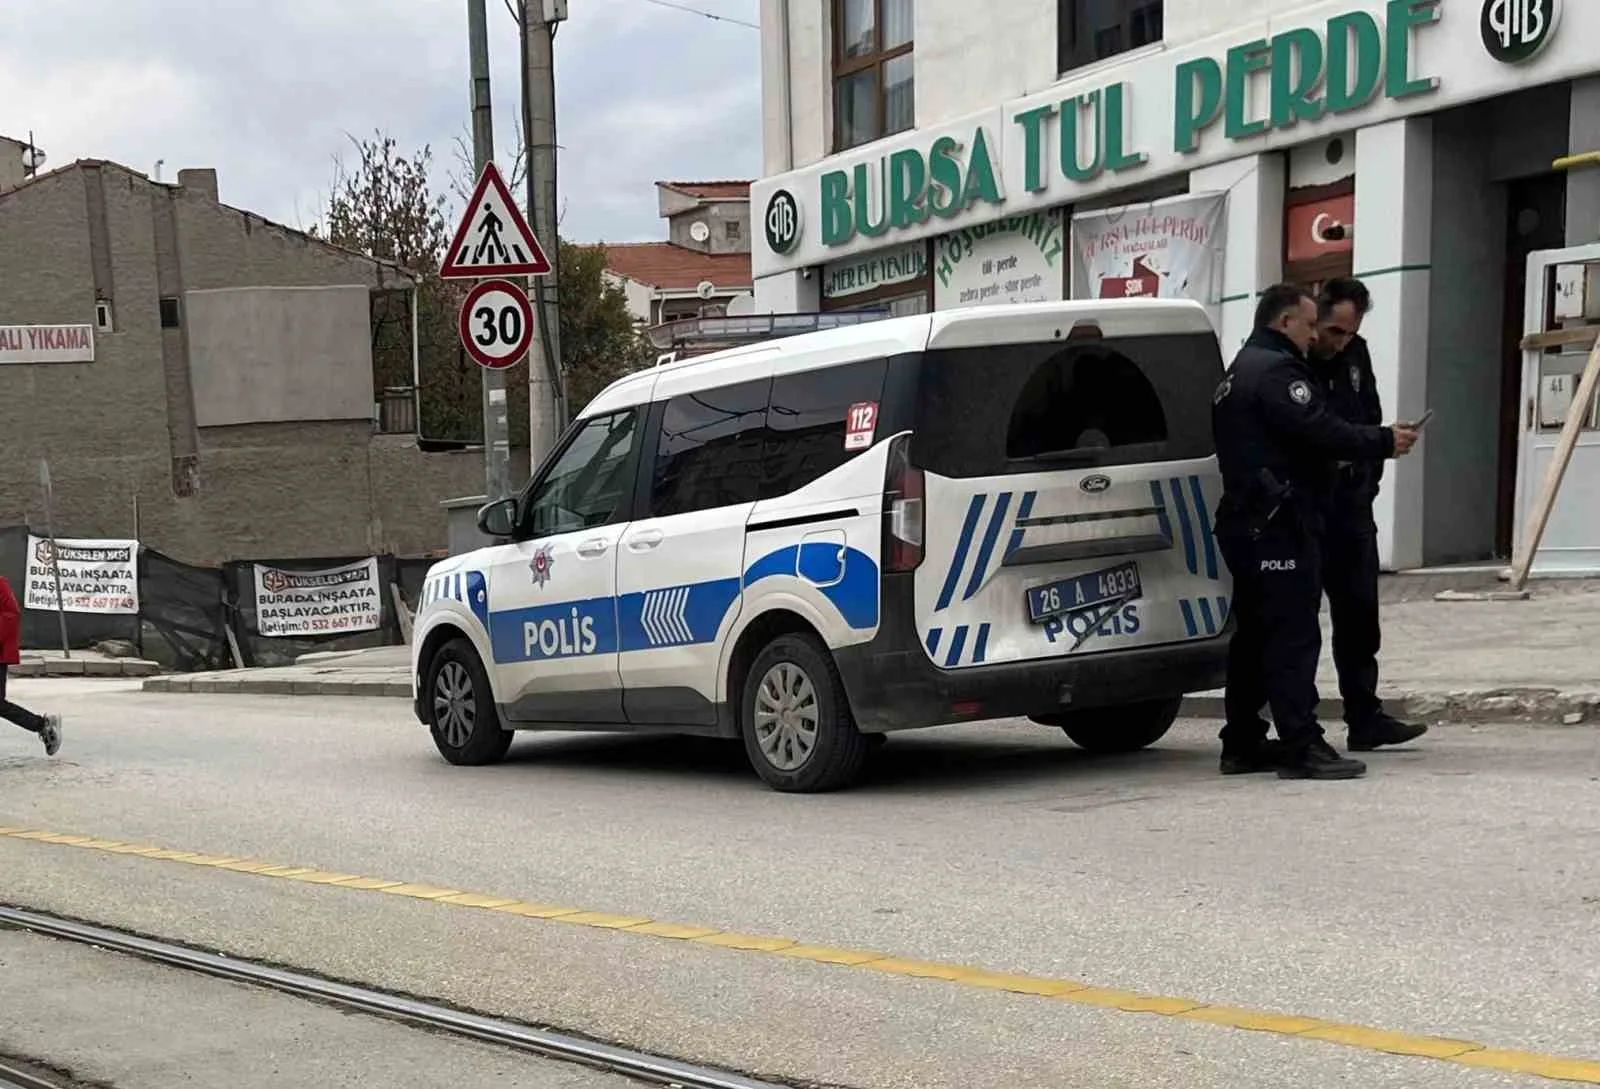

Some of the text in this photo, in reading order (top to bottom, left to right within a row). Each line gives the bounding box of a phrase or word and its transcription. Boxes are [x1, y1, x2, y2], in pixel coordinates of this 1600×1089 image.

[821, 0, 1440, 246] BURSA TÜL PERDE
[27, 327, 90, 350] YIKAMA
[475, 306, 521, 346] 30
[851, 406, 873, 431] 112
[31, 581, 131, 594] BAŞAYACAKTIR.
[259, 587, 376, 604] BURADA İNŞAATA
[1040, 568, 1135, 613] 26 A 4833
[261, 602, 375, 619] BAŞLAYACAKTIR.
[523, 607, 597, 657] POLİS
